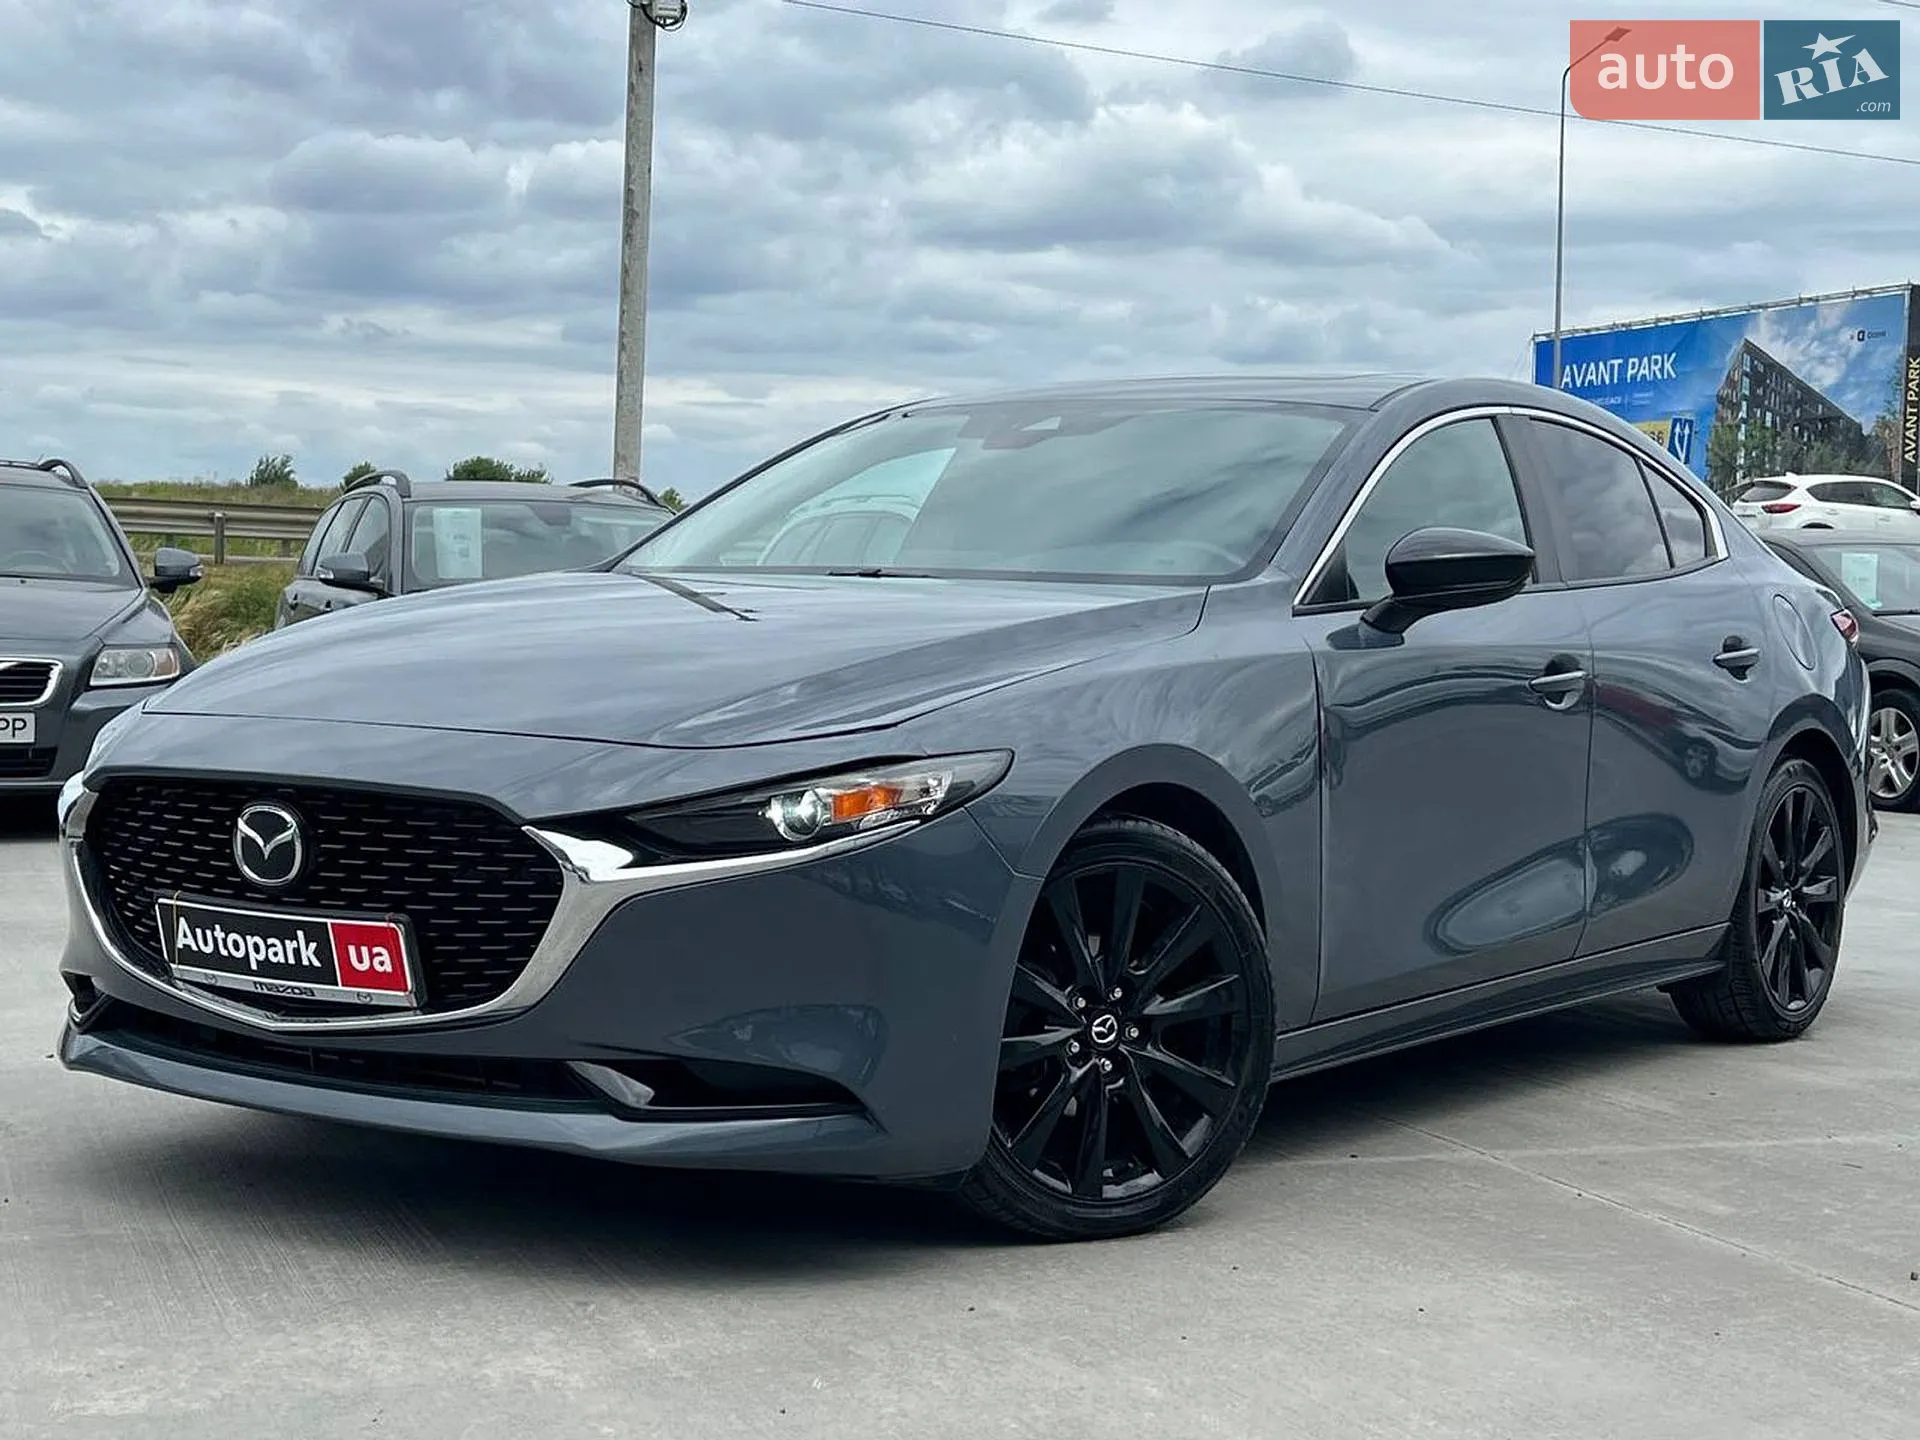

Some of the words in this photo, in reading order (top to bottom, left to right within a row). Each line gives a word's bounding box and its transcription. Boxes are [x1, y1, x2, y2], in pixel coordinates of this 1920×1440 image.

[1561, 359, 1623, 389] AVANT
[1627, 352, 1677, 383] PARK
[1907, 357, 1920, 401] PARK
[1904, 404, 1918, 463] AVANT
[176, 916, 322, 970] Autopark
[347, 944, 393, 973] ua
